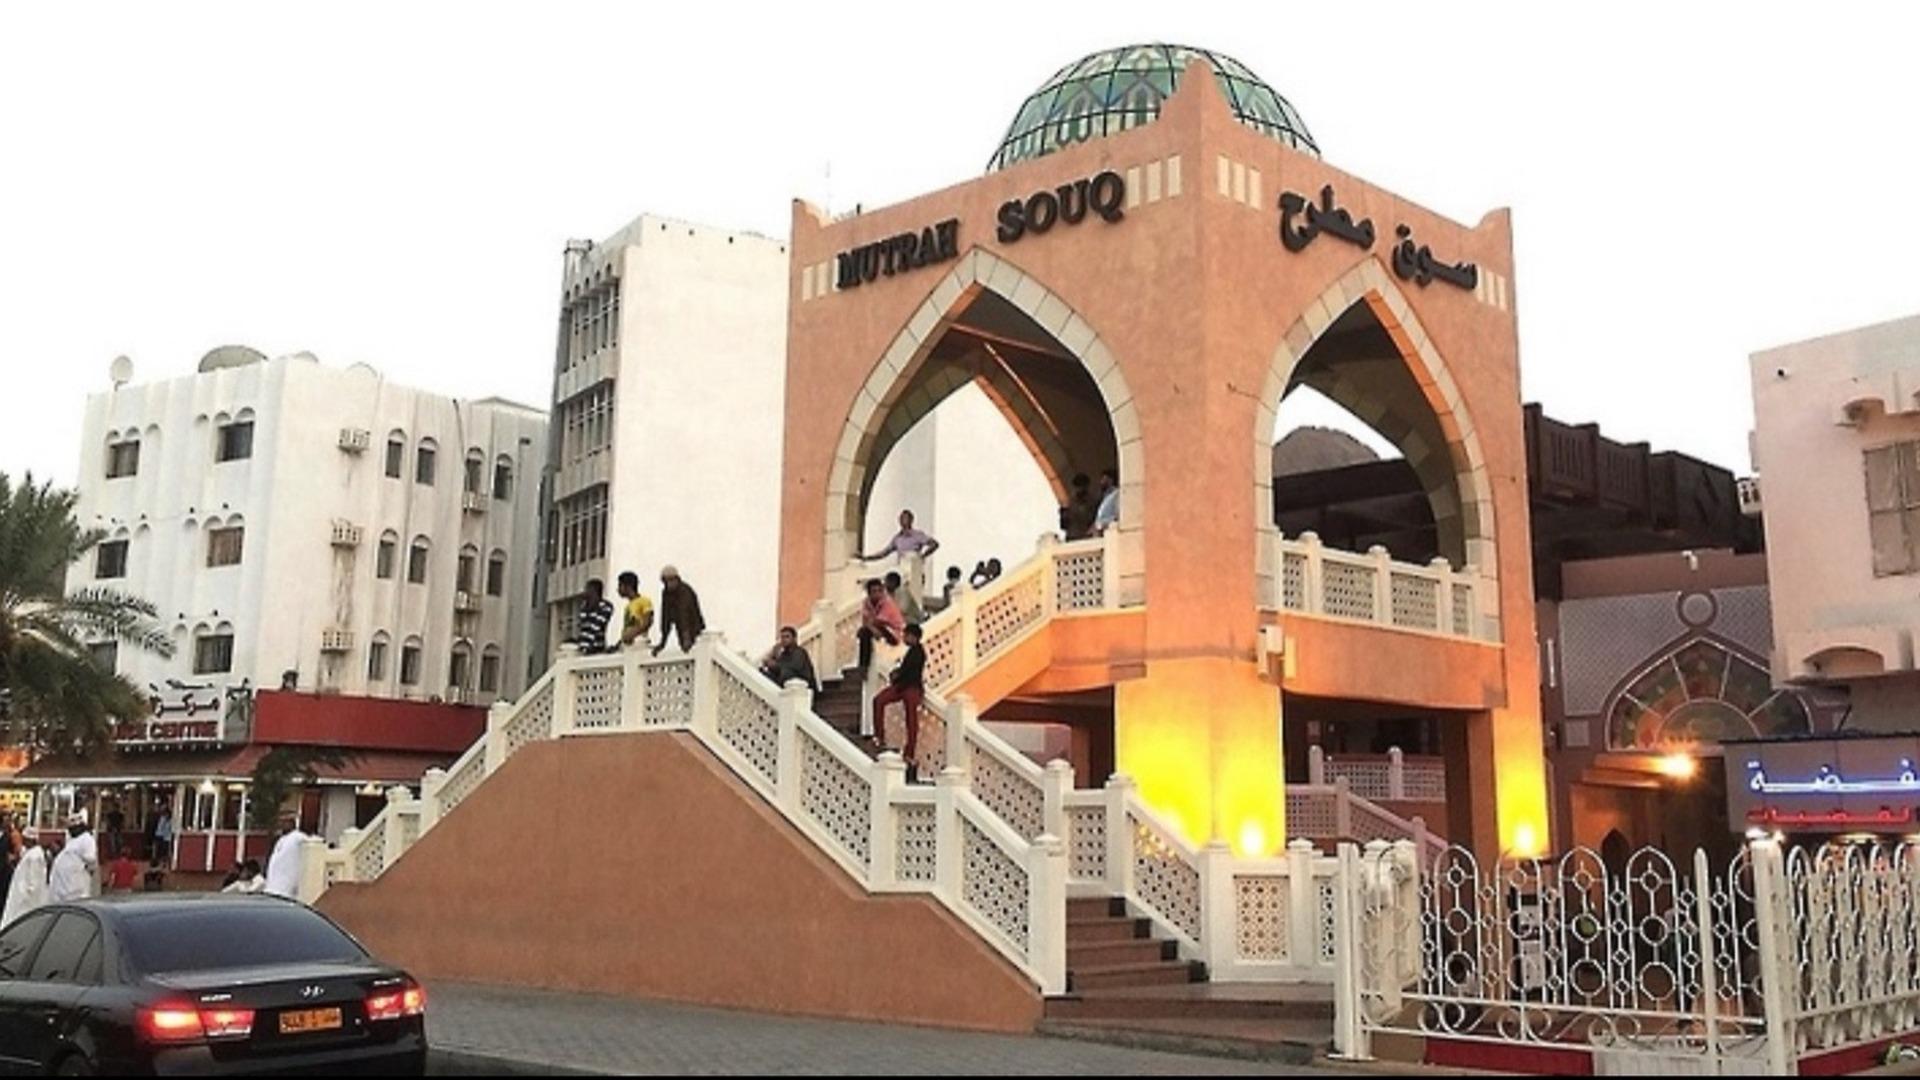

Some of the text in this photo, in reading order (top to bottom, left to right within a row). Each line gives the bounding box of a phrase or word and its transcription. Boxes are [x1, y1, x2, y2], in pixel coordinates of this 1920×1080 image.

[836, 171, 1125, 290] MUTRAH SOUQ
[1279, 184, 1478, 289] سوق مطرح
